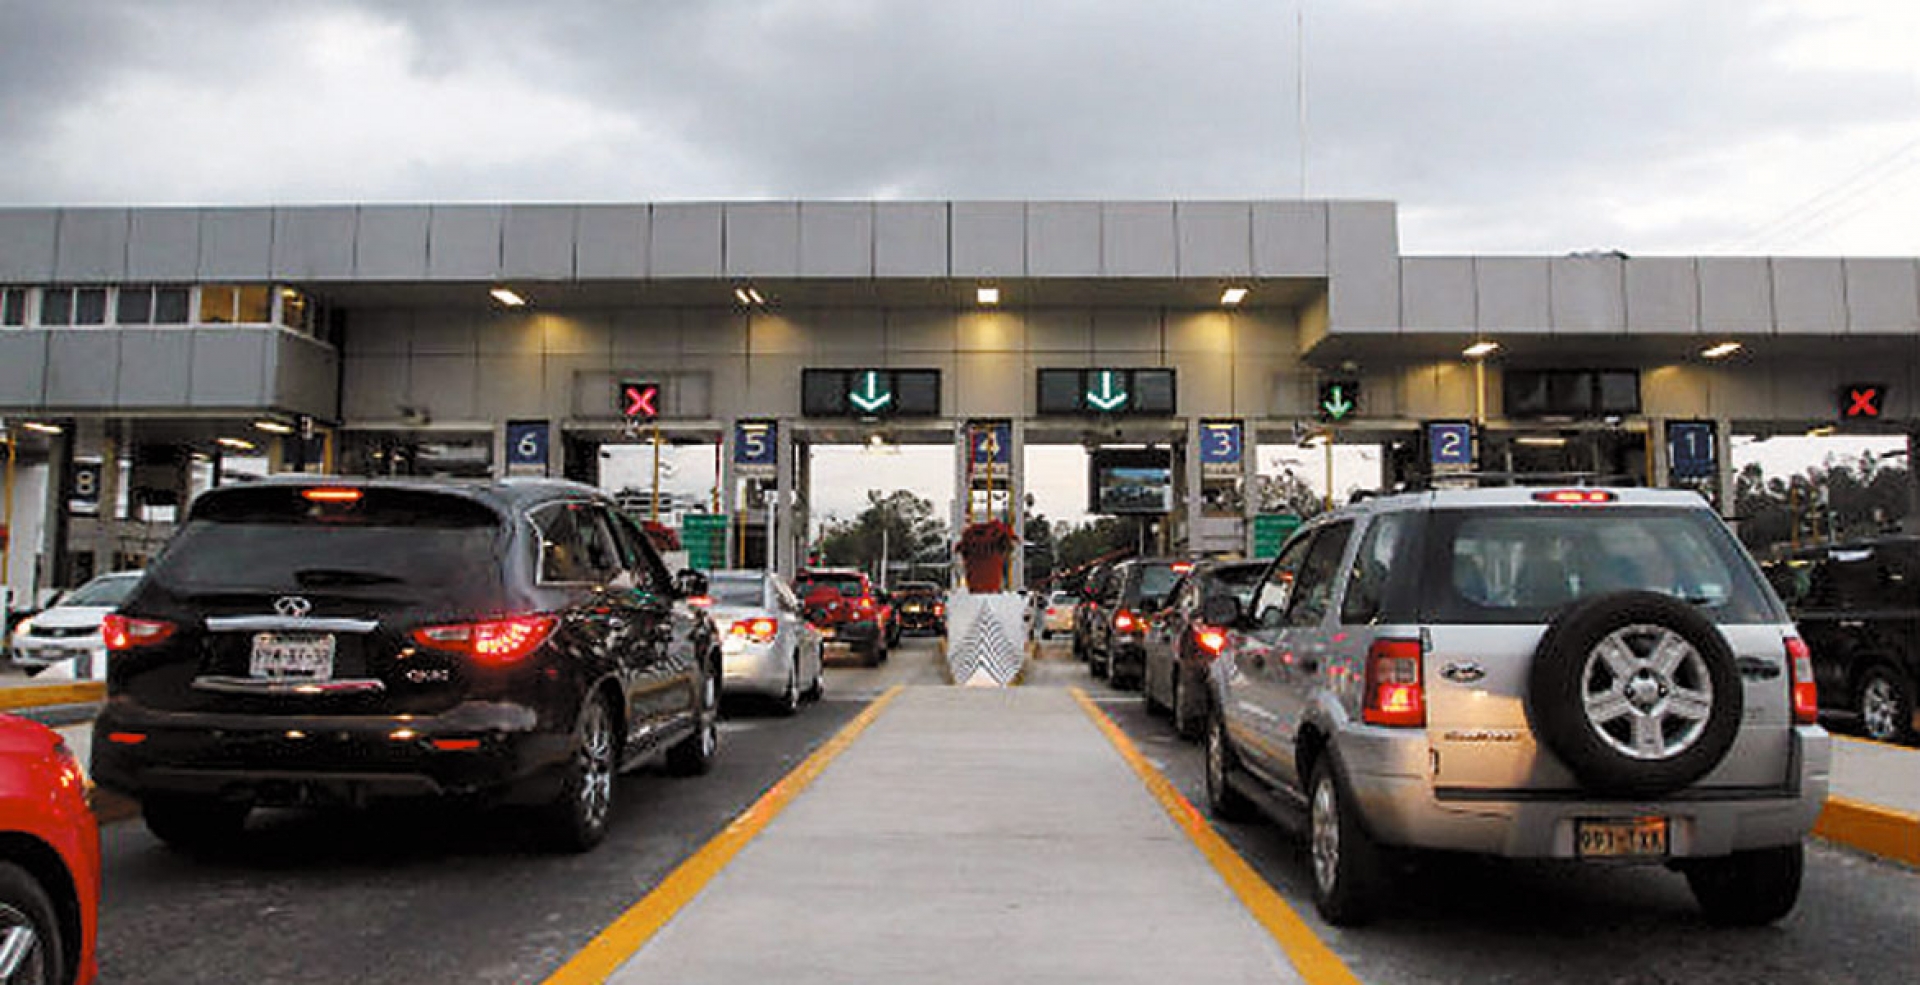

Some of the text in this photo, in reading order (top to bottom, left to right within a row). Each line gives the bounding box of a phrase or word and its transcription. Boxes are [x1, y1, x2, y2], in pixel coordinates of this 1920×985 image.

[518, 432, 537, 456] 6
[745, 431, 766, 456] 5
[977, 432, 1000, 456] 4
[1211, 431, 1231, 455] 3
[1441, 431, 1460, 456] 2
[76, 470, 95, 495] 8
